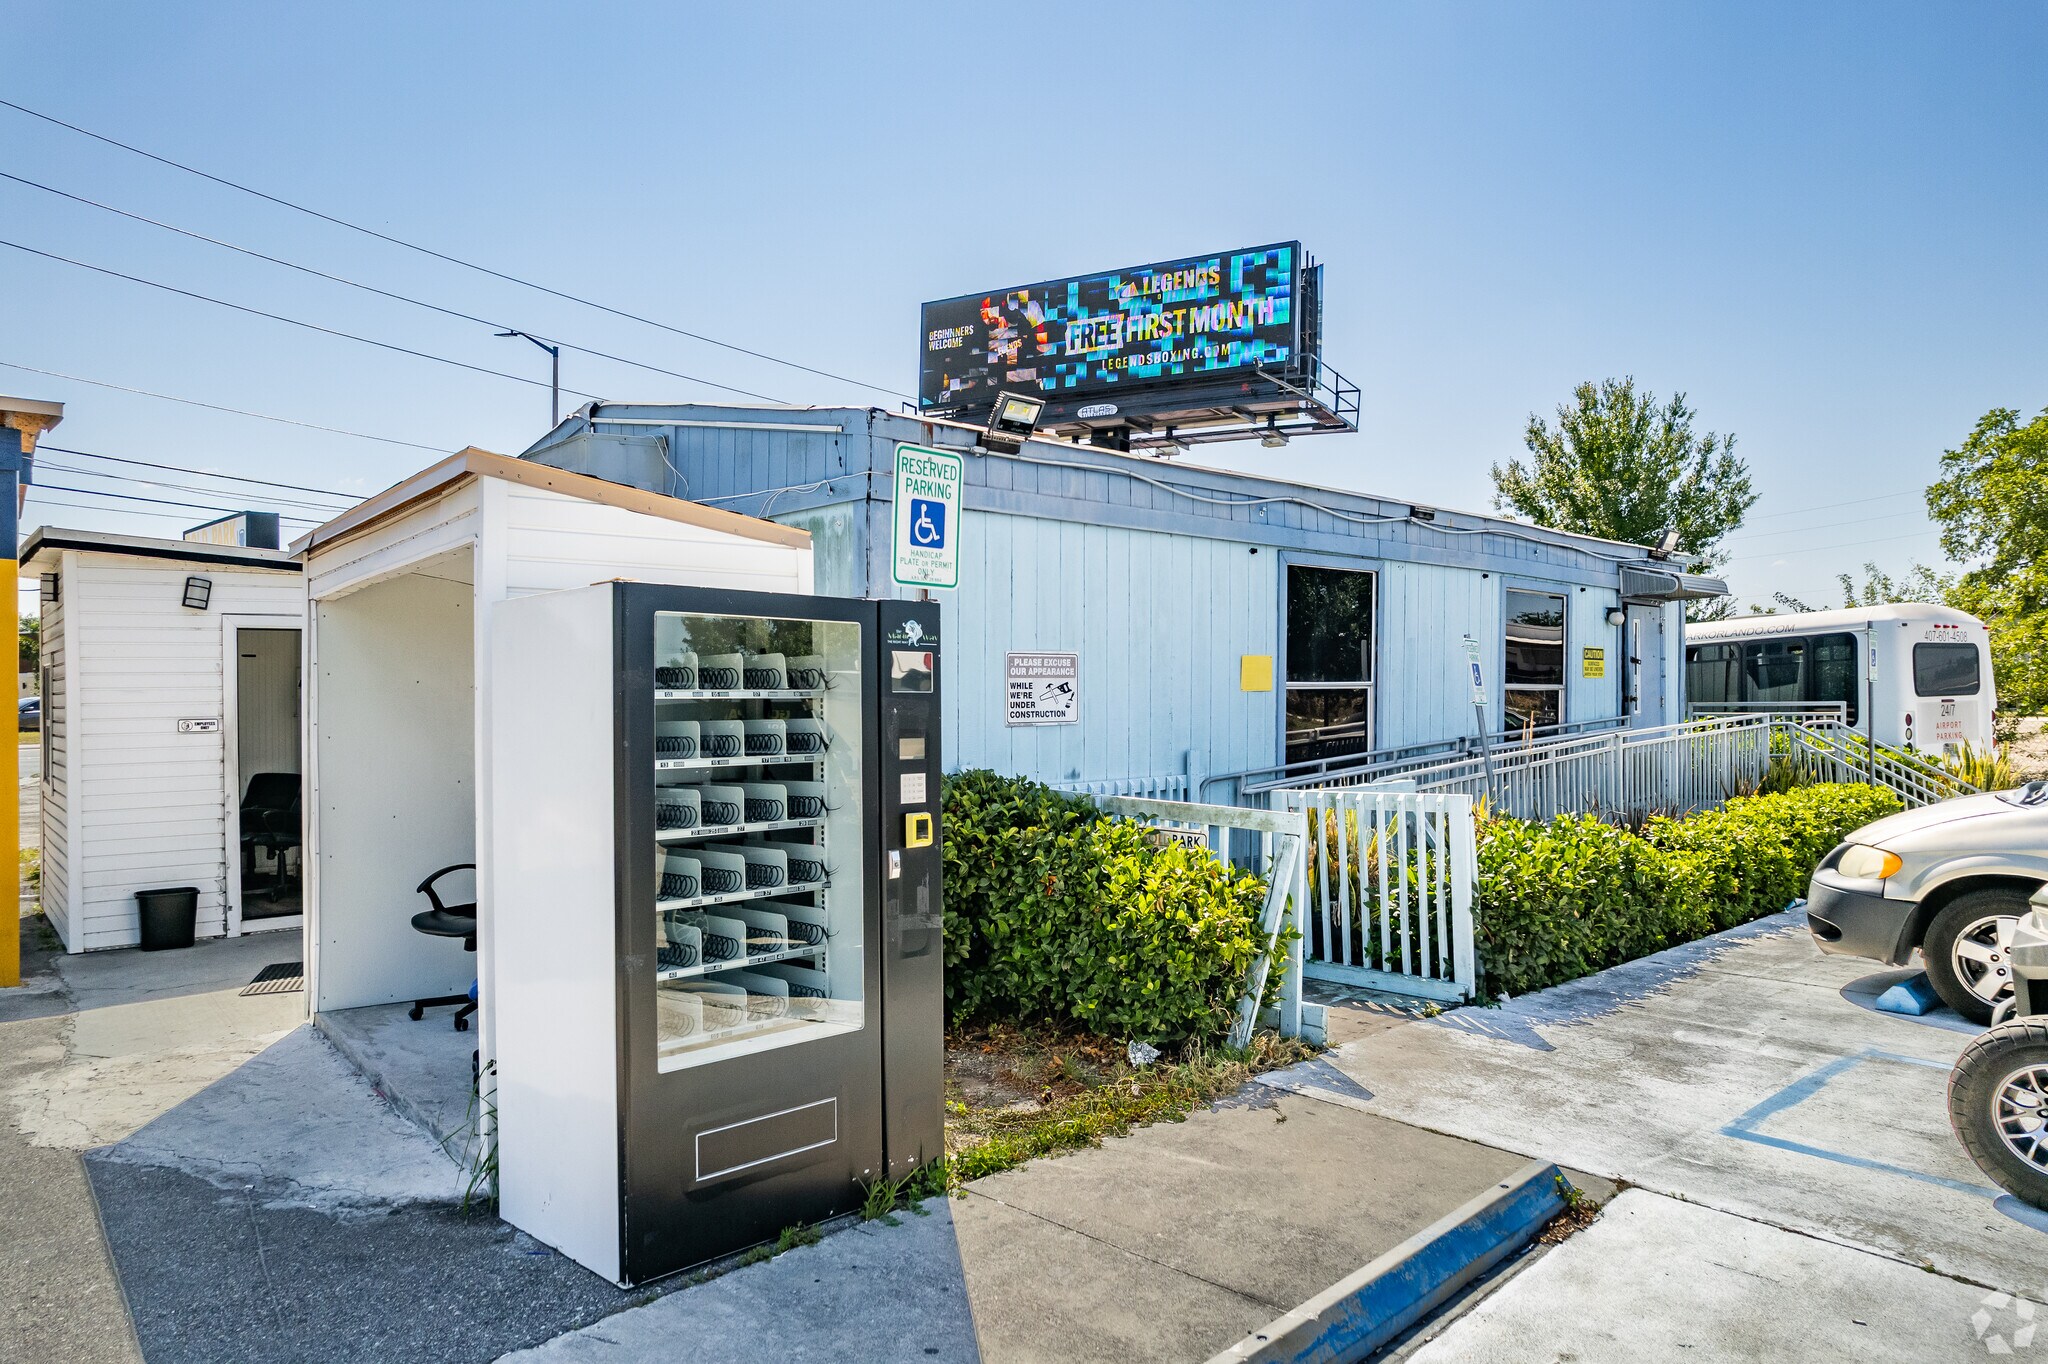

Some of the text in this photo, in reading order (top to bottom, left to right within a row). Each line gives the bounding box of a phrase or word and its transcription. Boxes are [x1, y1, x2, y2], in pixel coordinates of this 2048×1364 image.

[1143, 266, 1220, 294] LEGENDS
[1069, 296, 1274, 351] FREE FIRST MONTH
[928, 336, 963, 351] WELCOME
[1102, 344, 1230, 370] LEGENDSBOXING.COM
[1082, 406, 1110, 414] ATLAS
[901, 456, 957, 481] RESERVED
[906, 478, 952, 500] PARKING
[910, 550, 943, 560] HANDICAP
[900, 557, 920, 566] PLATE
[930, 560, 952, 570] PERMIT
[918, 568, 934, 576] ONLY
[1584, 650, 1603, 659] CAUTION
[1014, 658, 1071, 667] PLEASE EXCUSE
[1010, 710, 1066, 718] CONSTRUCTION
[1940, 704, 1956, 716] 24/7
[1936, 721, 1962, 730] AIRPORT
[1936, 732, 1963, 740] PARKING
[1172, 834, 1201, 848] PARK
